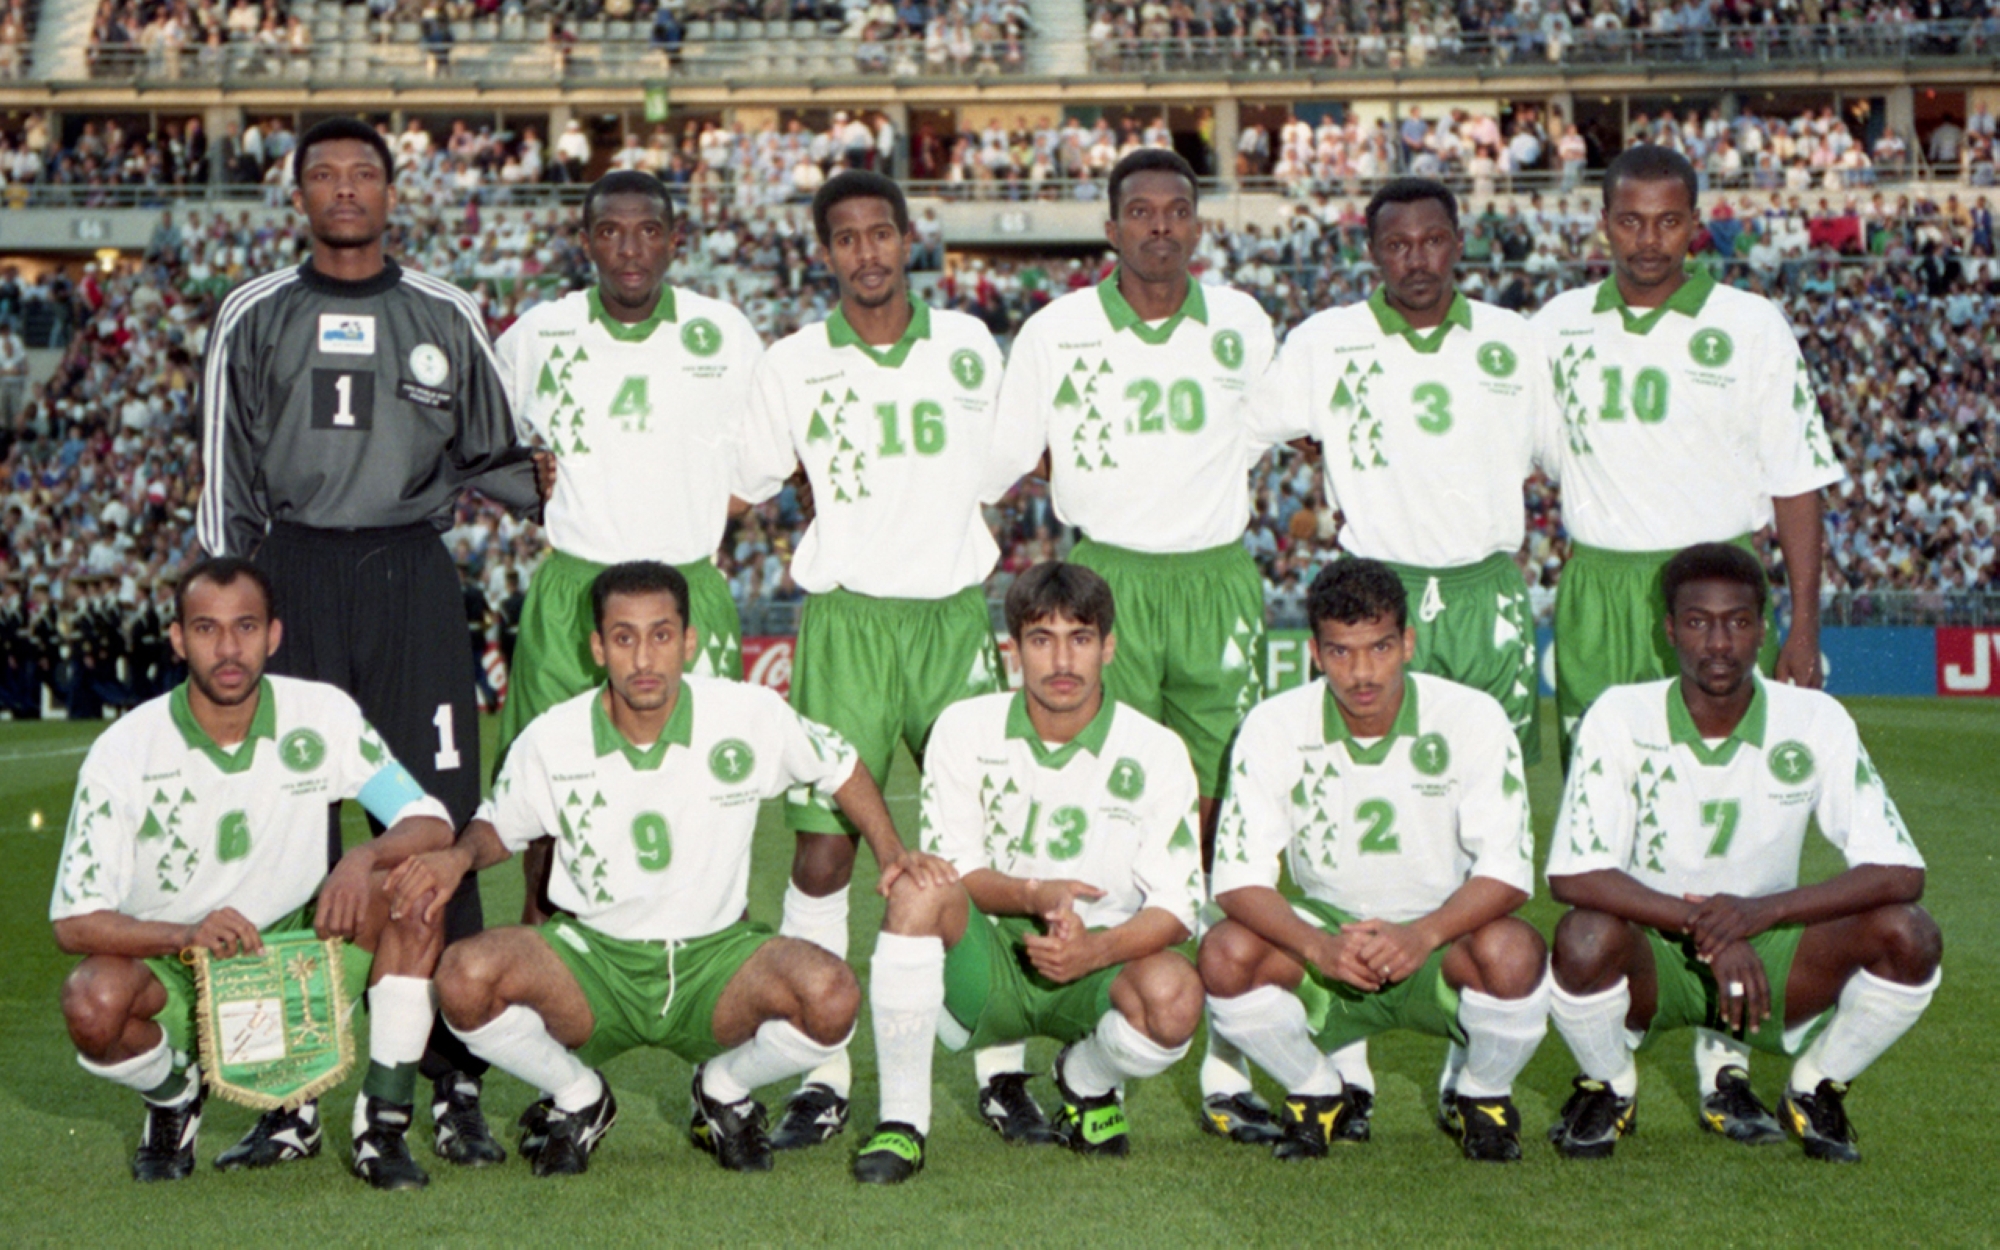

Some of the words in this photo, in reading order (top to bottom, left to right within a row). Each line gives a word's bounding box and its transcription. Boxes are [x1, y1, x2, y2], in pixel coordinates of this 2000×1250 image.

[333, 375, 355, 425] 1
[609, 375, 650, 431] 4
[1124, 377, 1206, 434] 20
[1411, 381, 1454, 435] 3
[1599, 366, 1671, 424] 10
[873, 398, 947, 457] 16
[1944, 633, 2000, 690] J
[433, 703, 460, 770] 1
[216, 808, 252, 865] 6
[630, 810, 672, 874] 9
[1020, 801, 1090, 861] 13
[1355, 797, 1401, 855] 2
[1700, 798, 1741, 858] 7
